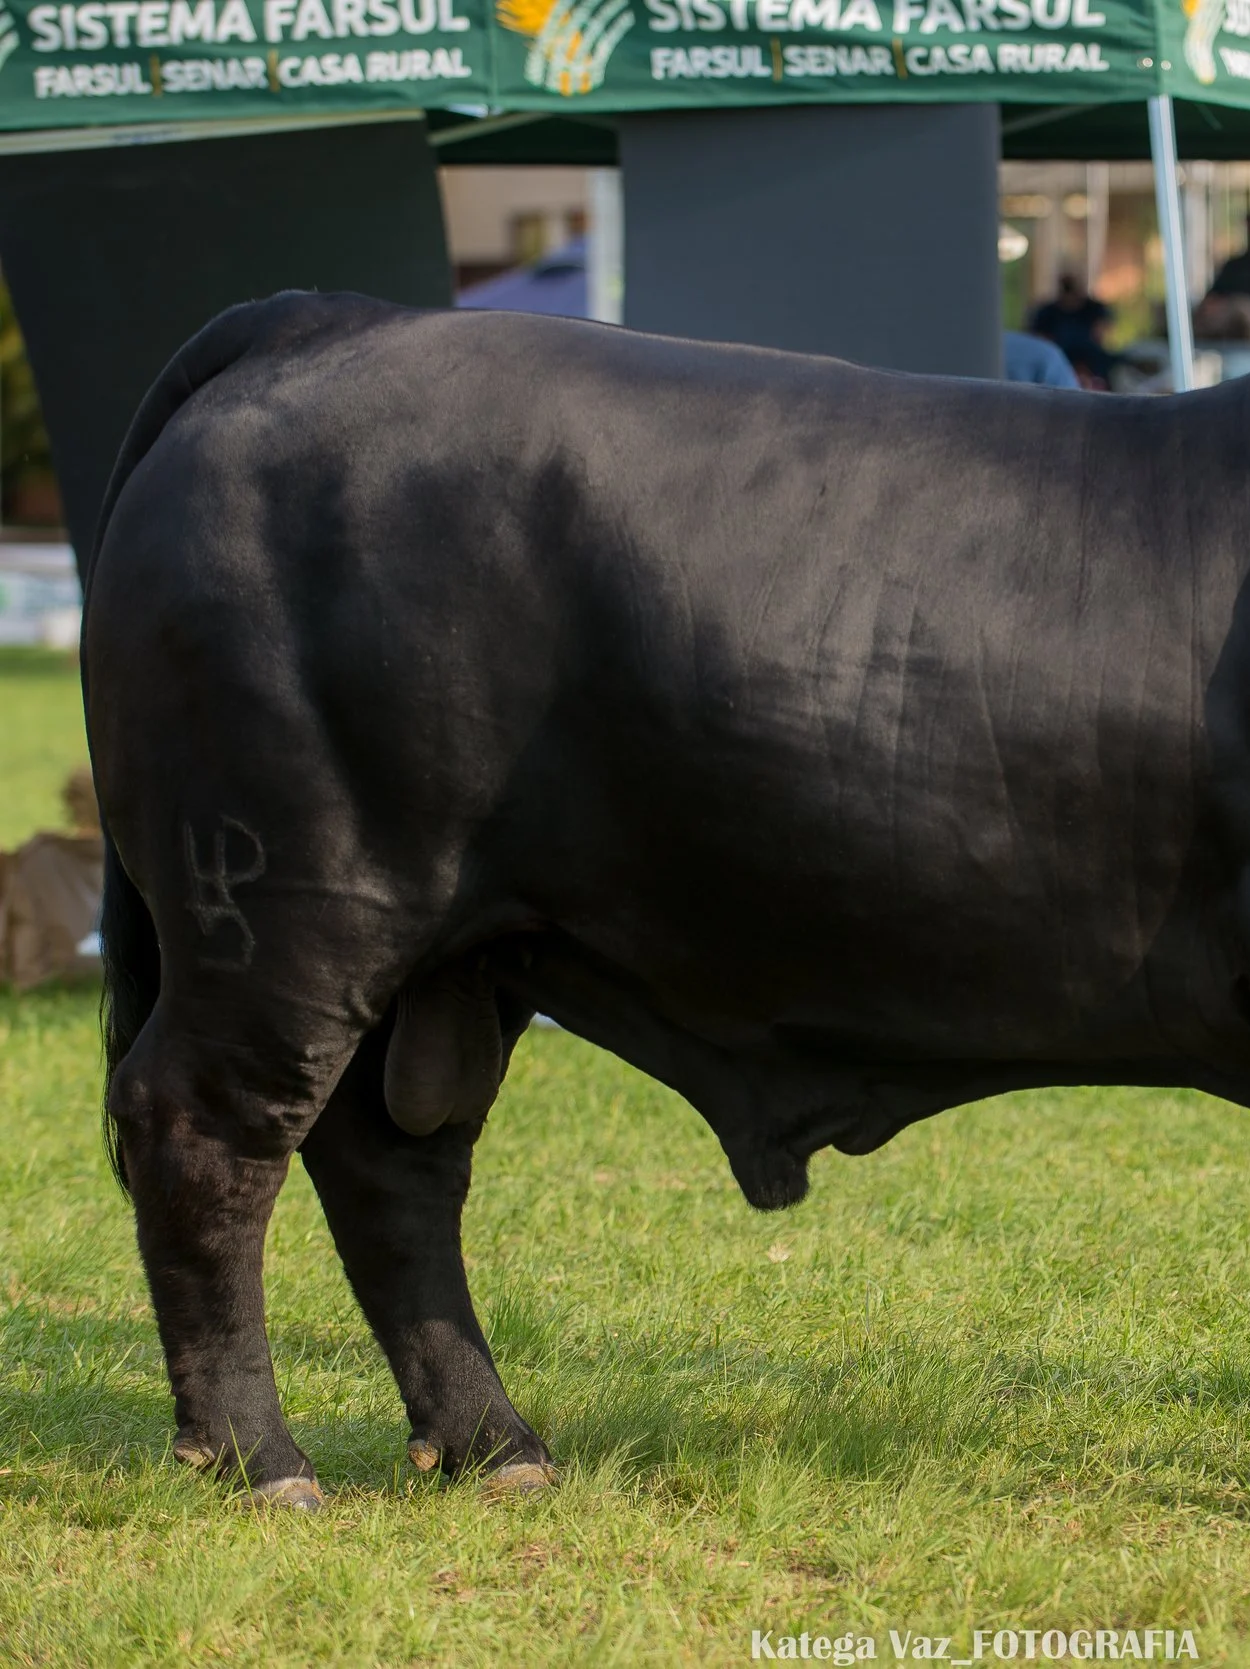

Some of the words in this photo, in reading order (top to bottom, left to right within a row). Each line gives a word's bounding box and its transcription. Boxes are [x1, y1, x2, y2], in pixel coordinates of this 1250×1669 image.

[28, 0, 257, 52] SISTEMA
[264, 0, 471, 43] FARSUL
[646, 0, 882, 32] SISTEMA
[892, 0, 1106, 34] FARSUL
[34, 62, 152, 98] FARSUL
[161, 56, 268, 92] SENAR
[277, 52, 364, 88] CASA
[365, 47, 472, 82] RURAL
[652, 46, 772, 80] FARSUL
[783, 45, 895, 76] SENAR
[906, 44, 995, 76] CASA
[997, 43, 1110, 72] RURAL
